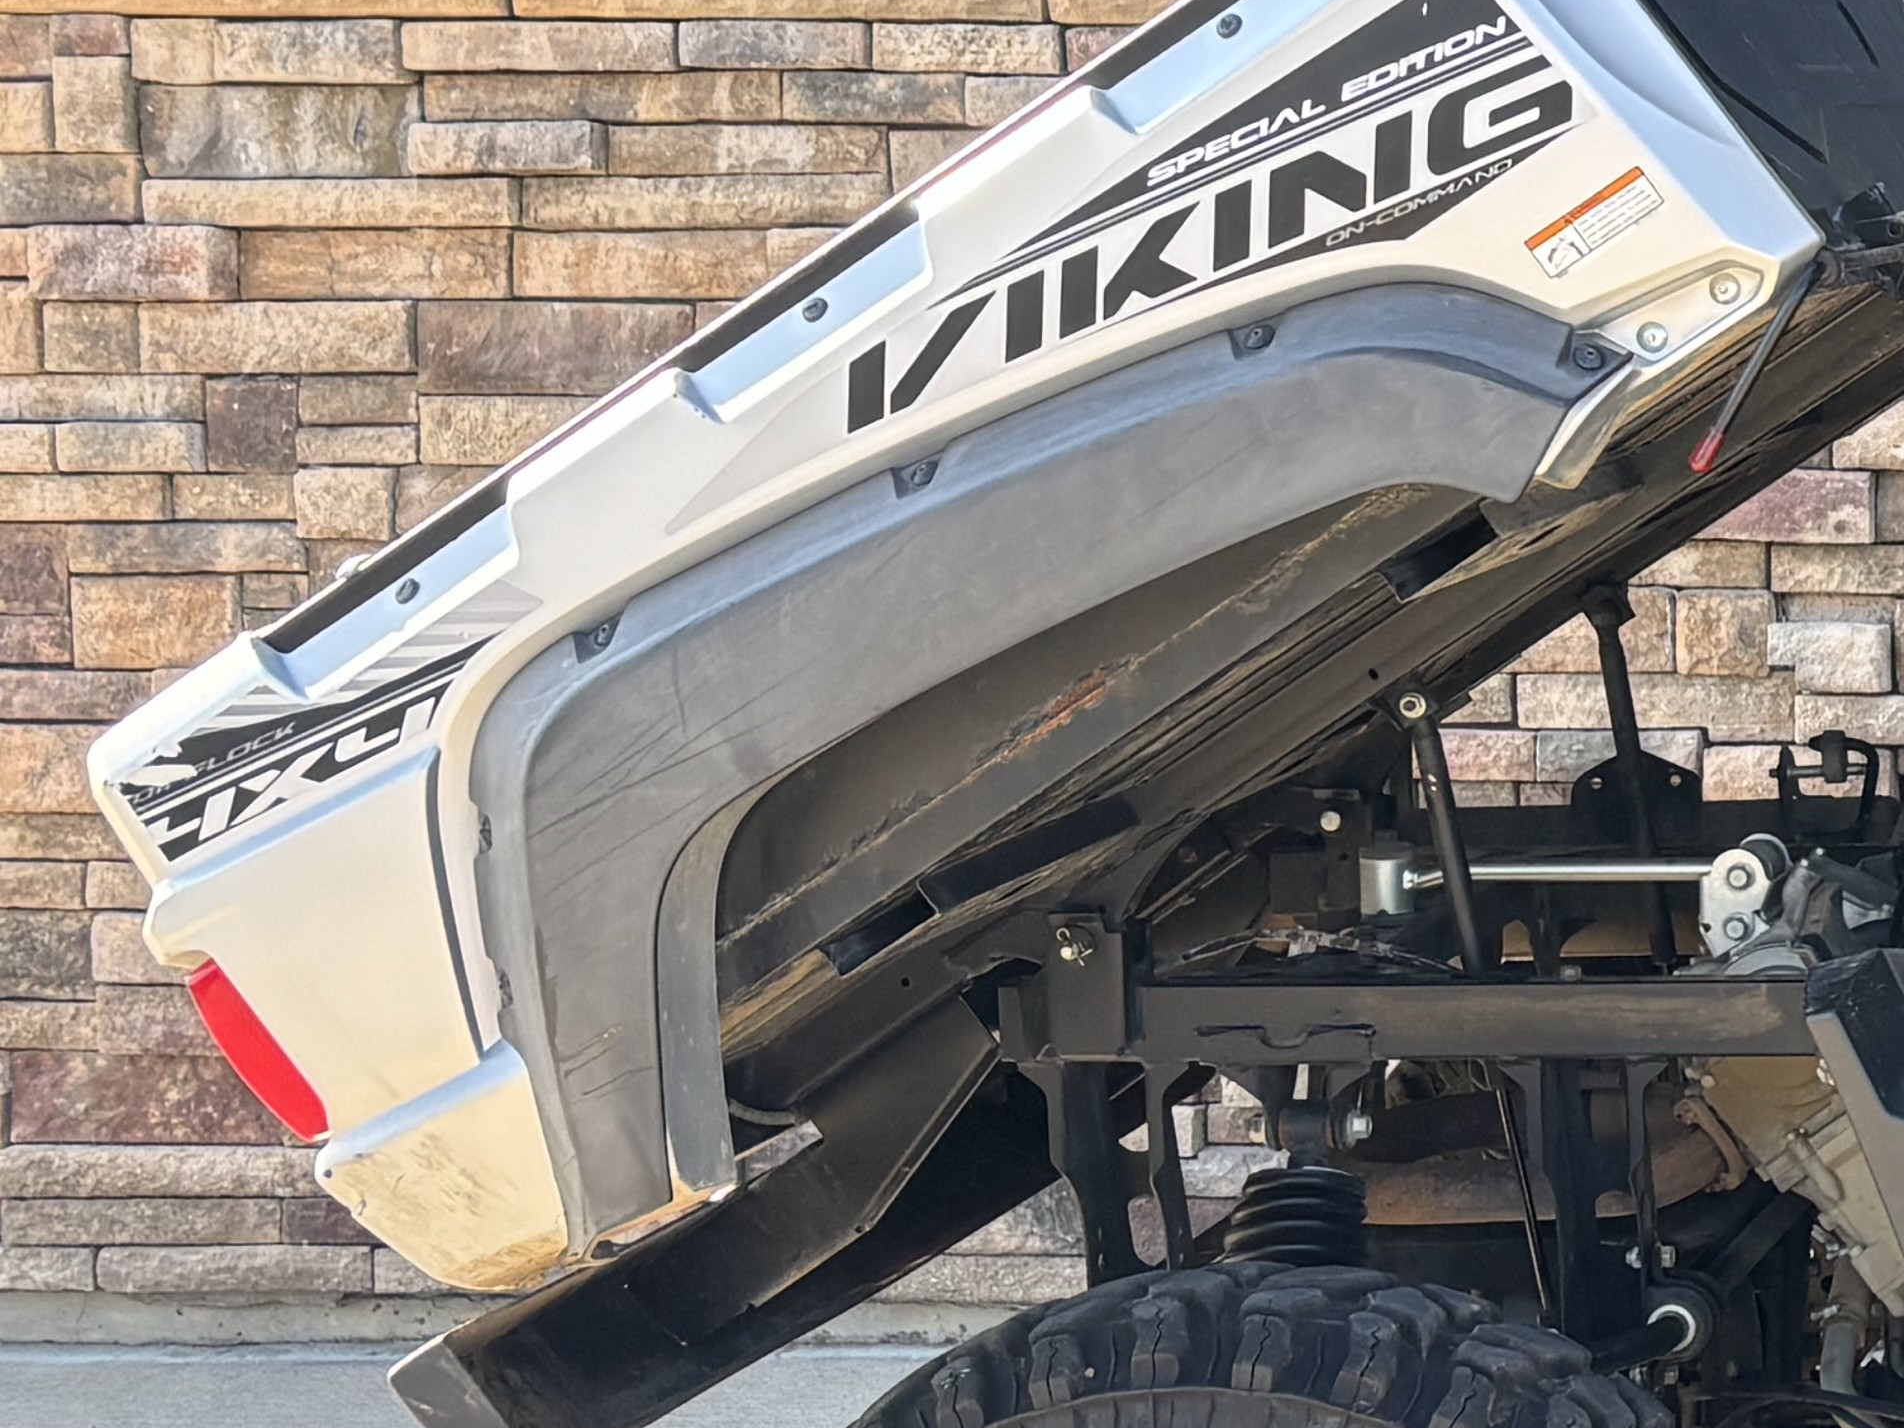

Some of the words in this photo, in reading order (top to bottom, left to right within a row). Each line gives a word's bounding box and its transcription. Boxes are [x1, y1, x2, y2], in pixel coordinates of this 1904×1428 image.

[1147, 98, 1327, 187] SPECIAL
[1341, 16, 1507, 103] EDITION
[848, 53, 1573, 435] VIKING
[1325, 158, 1513, 247] ON-COMMAND
